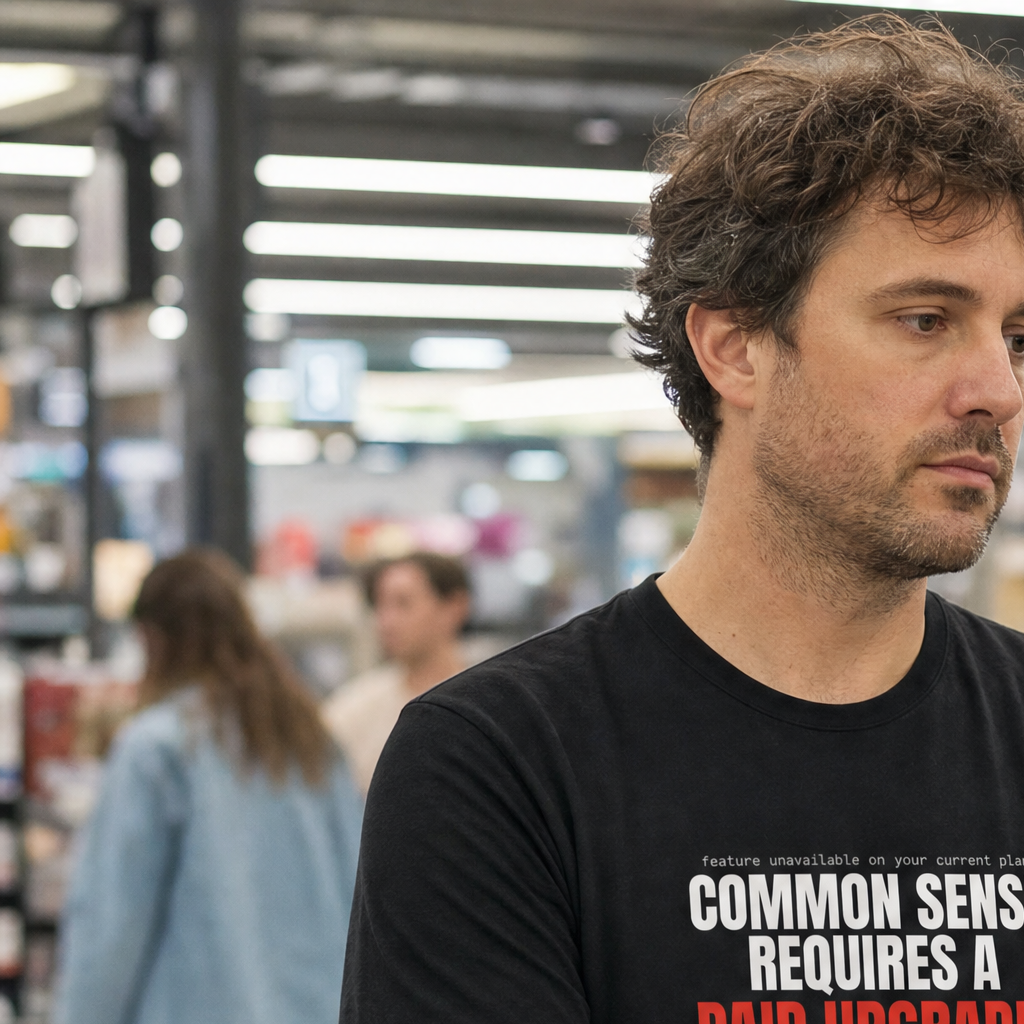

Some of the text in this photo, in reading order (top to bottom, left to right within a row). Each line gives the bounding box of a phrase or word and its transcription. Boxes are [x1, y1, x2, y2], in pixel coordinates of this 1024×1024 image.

[702, 855, 761, 867] feature
[769, 854, 860, 866] unavailable
[868, 856, 886, 866] on
[894, 856, 928, 868] your
[936, 855, 992, 866] current
[688, 873, 902, 931] COMMON
[748, 934, 1002, 996] REQUIRES A
